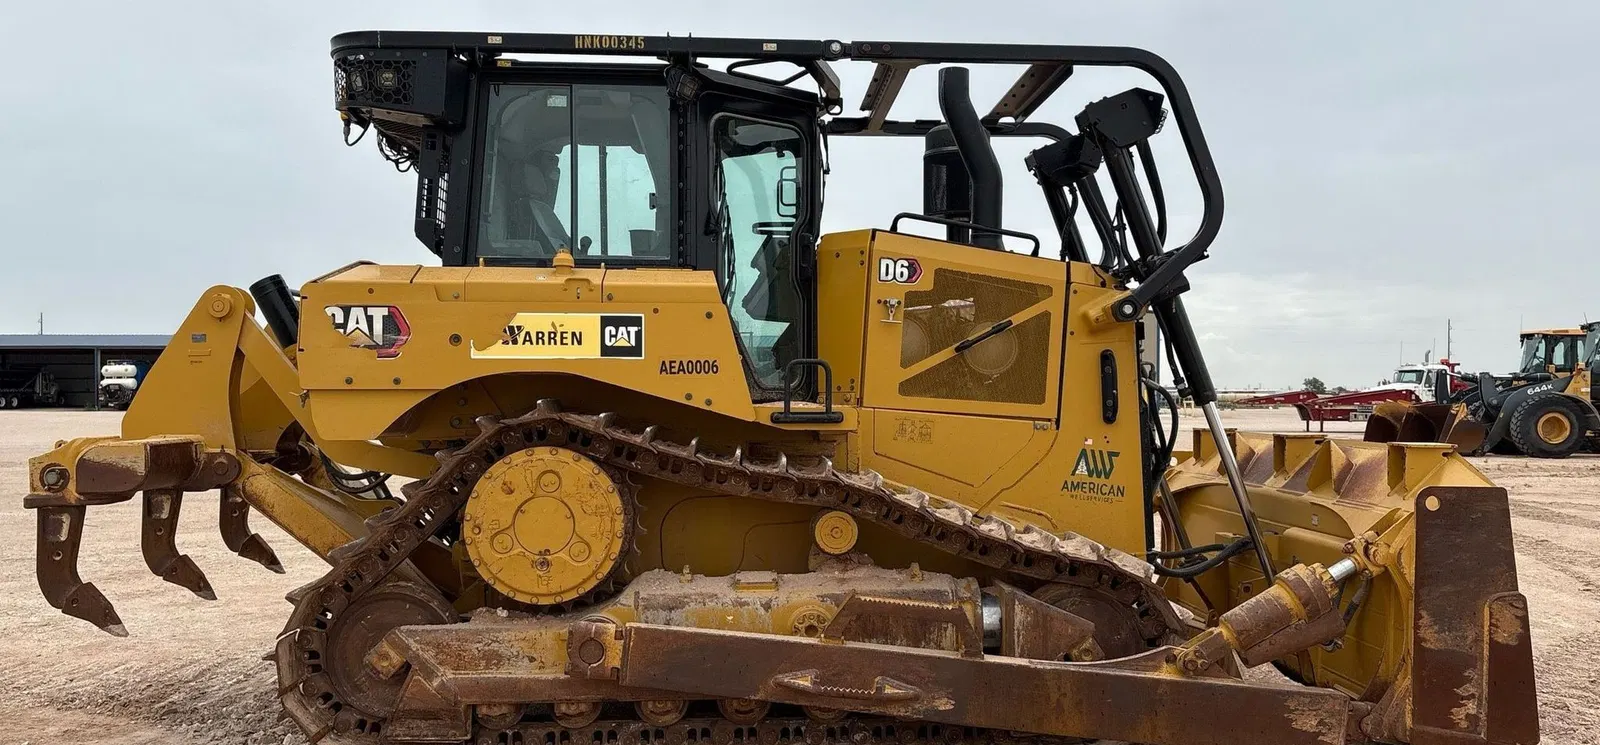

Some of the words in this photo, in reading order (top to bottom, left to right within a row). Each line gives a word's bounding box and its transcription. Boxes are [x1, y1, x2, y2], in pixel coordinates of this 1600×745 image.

[574, 35, 646, 50] HNK00345
[879, 257, 909, 282] D6
[501, 324, 583, 346] WARREN
[604, 325, 639, 347] CAT
[659, 359, 720, 376] AEA0006
[1527, 383, 1554, 396] 644K
[1060, 479, 1125, 498] AMERICAN
